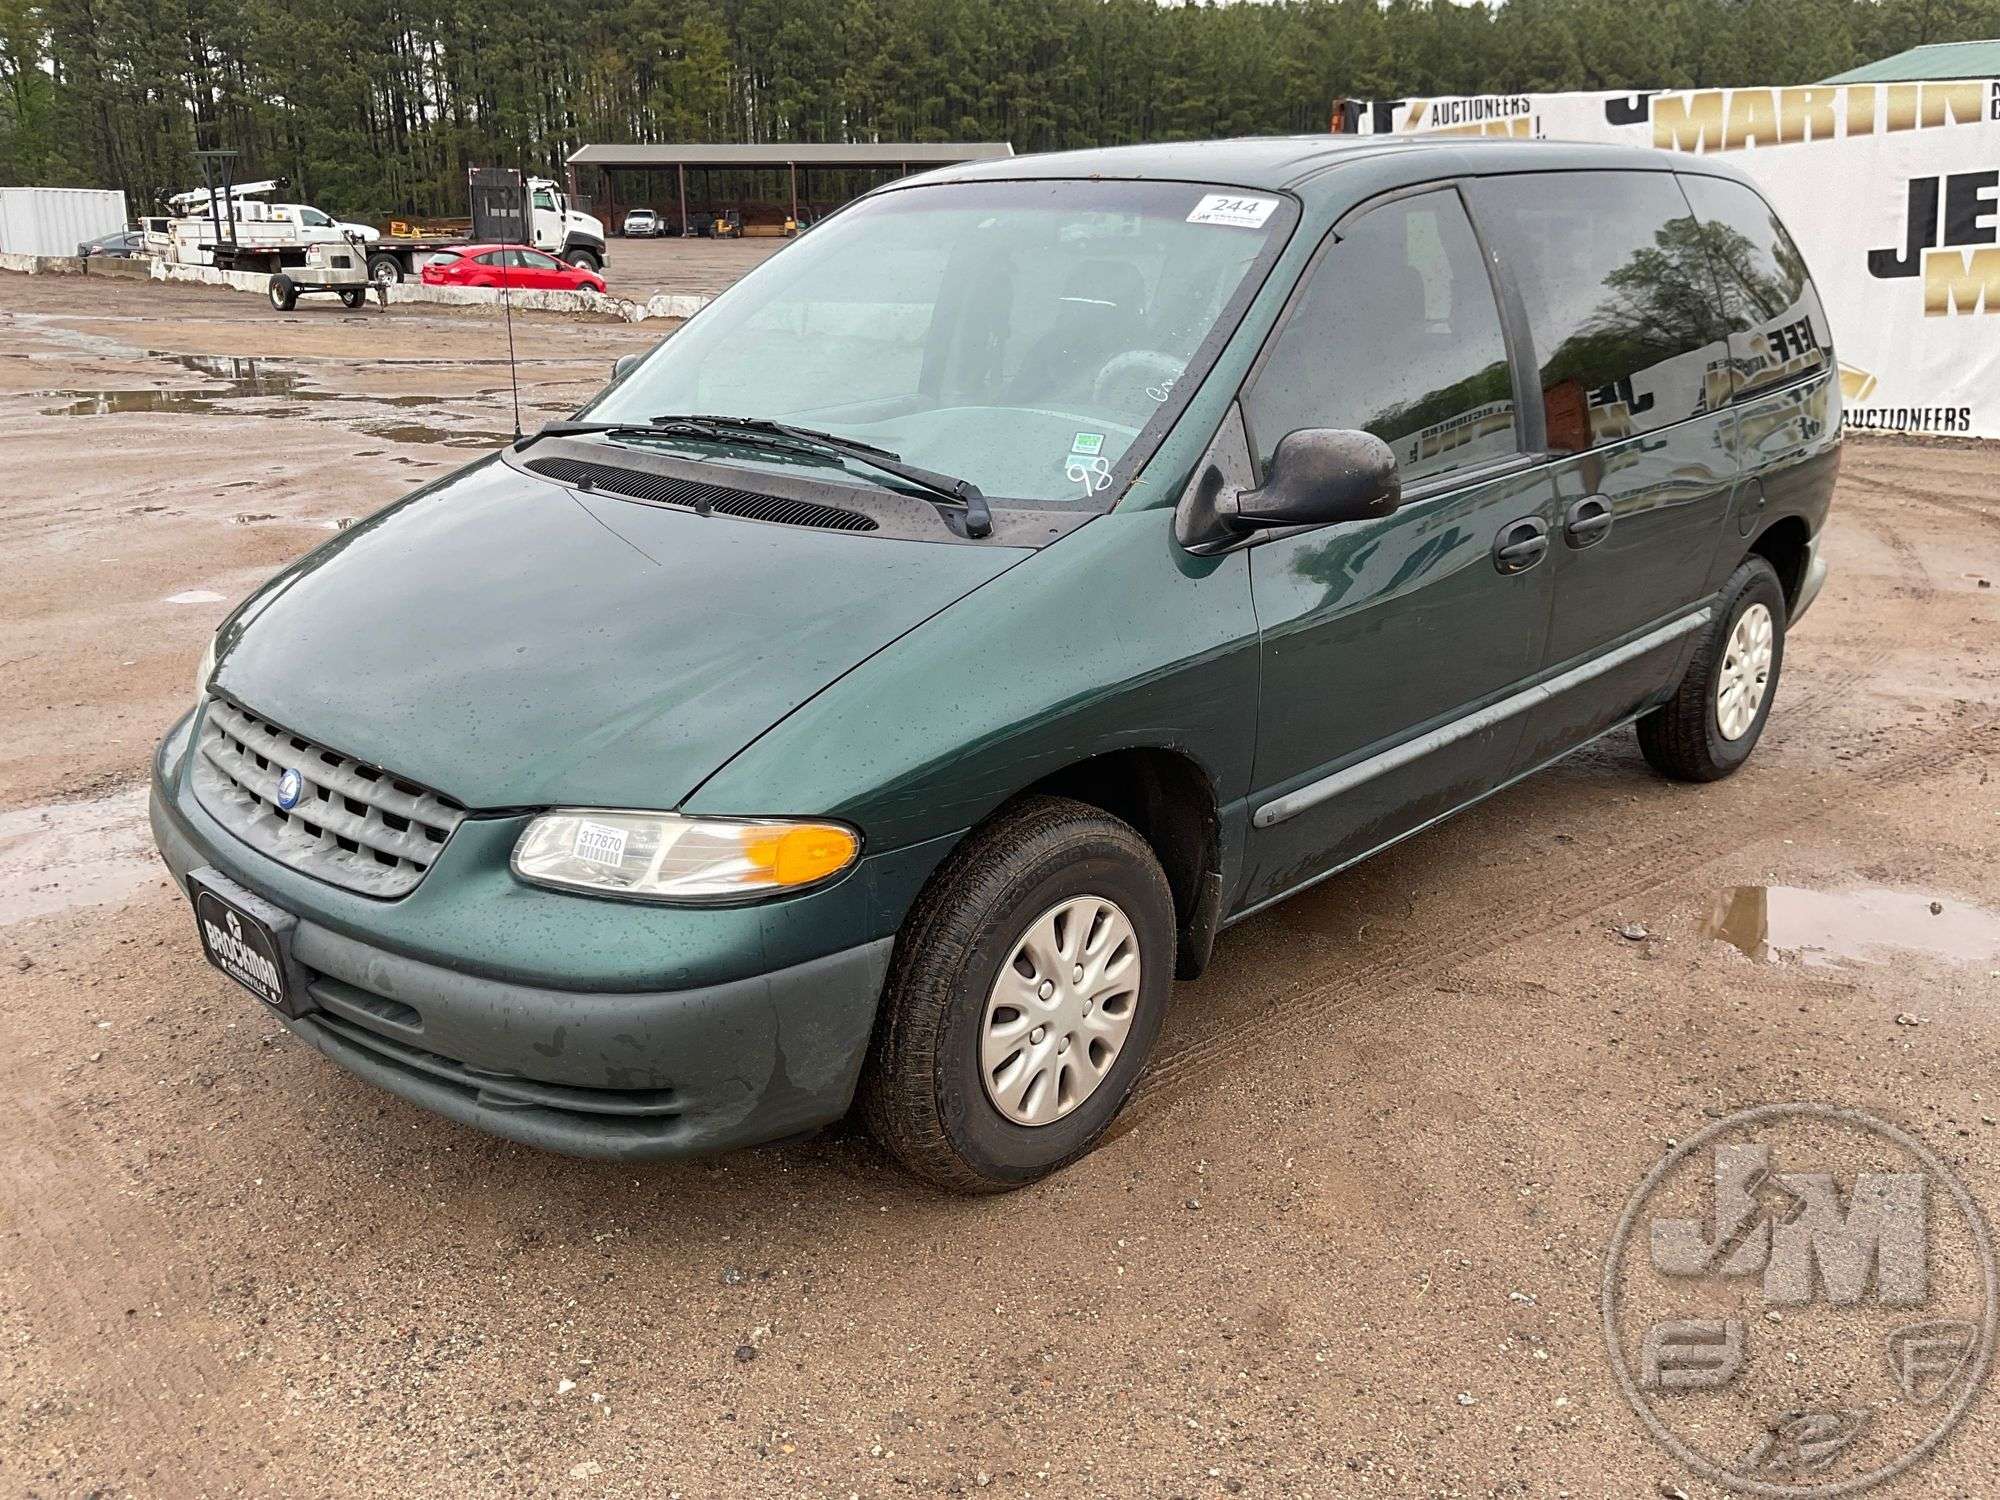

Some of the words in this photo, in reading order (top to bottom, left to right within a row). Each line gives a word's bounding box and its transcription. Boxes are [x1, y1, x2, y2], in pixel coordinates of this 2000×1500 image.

[1431, 98, 1530, 126] AUCTIONEERS
[1211, 199, 1260, 214] 244
[1842, 408, 1970, 431] AUCTIONEERS
[1067, 456, 1113, 497] 98
[580, 830, 622, 852] 317870
